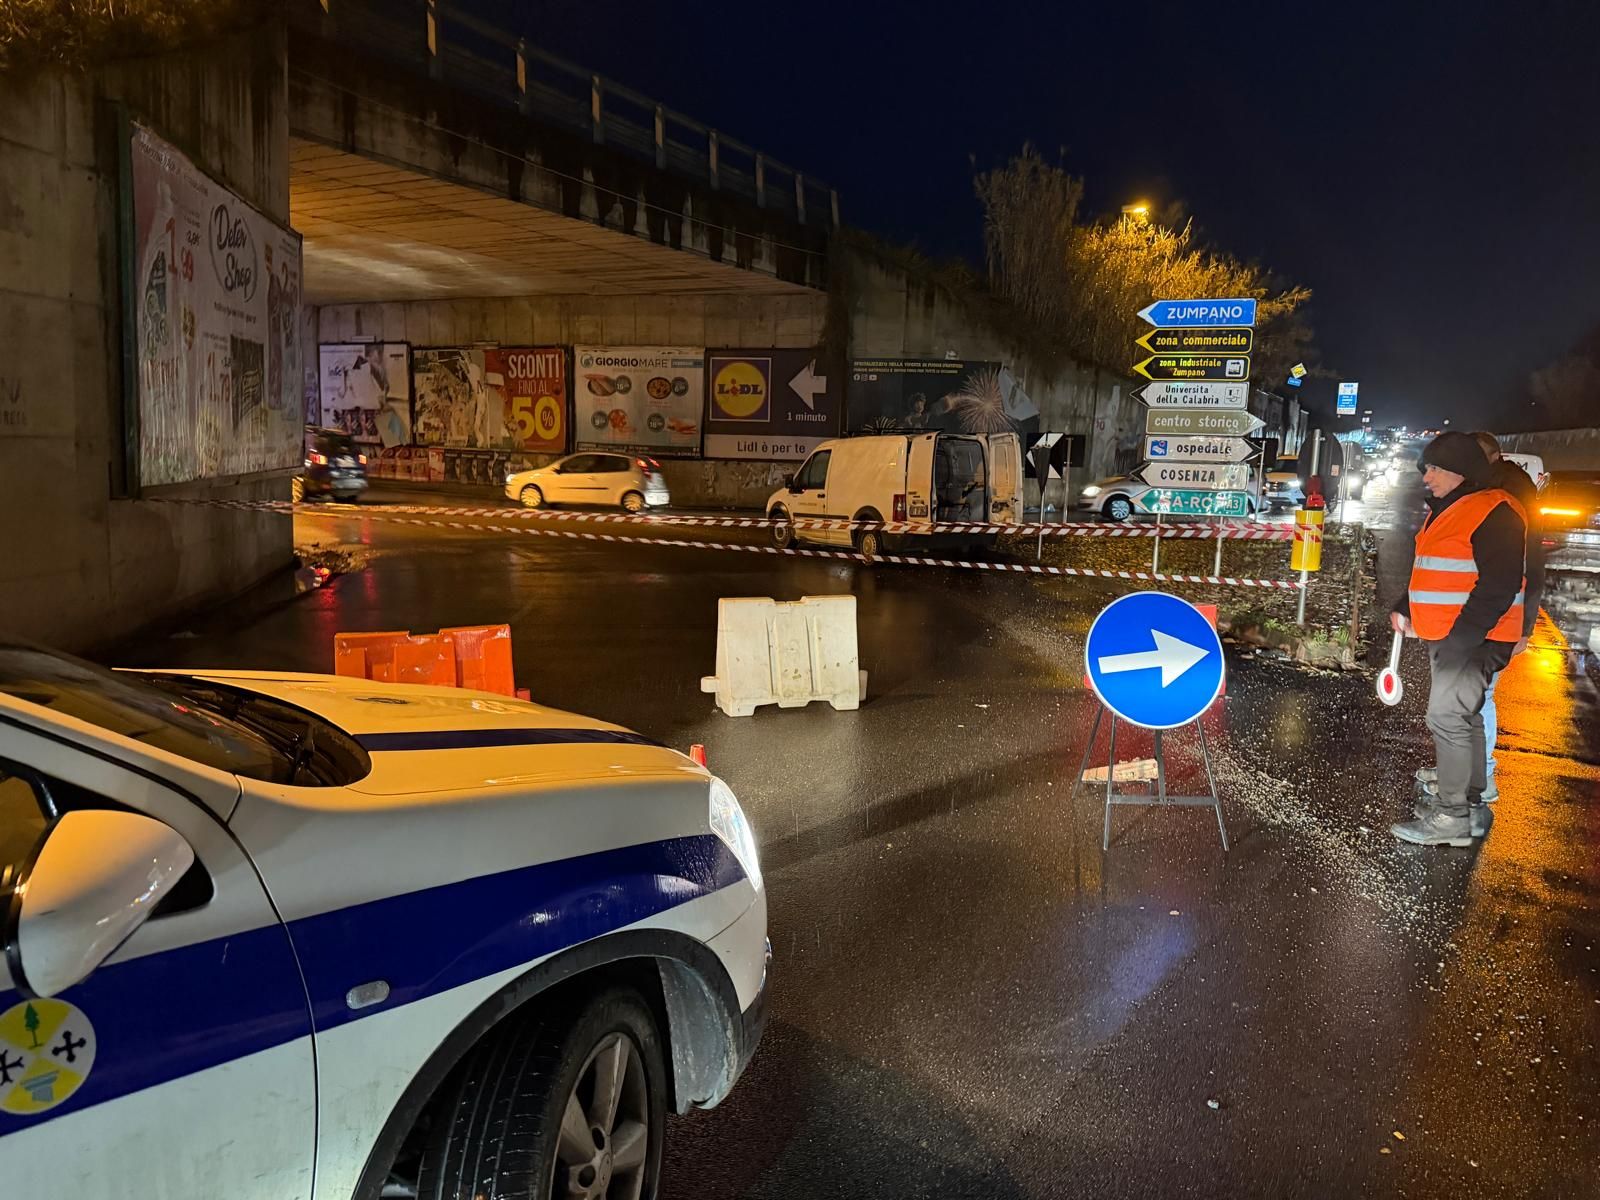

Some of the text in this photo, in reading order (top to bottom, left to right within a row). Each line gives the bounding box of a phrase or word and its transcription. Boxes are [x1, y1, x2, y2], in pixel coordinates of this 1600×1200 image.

[224, 253, 251, 299] Shop
[1167, 305, 1243, 320] ZUMPANO
[1156, 334, 1247, 346] zona commerciale
[1159, 358, 1222, 367] zona industriale
[1172, 368, 1206, 377] Zumpano
[518, 380, 550, 395] FINO AL
[1156, 395, 1219, 405] della Calabria
[795, 412, 827, 422] minuto
[1154, 415, 1239, 429] centro storico
[737, 440, 806, 455] Lidl è per te
[1176, 442, 1232, 456] ospedale
[1160, 469, 1216, 482] COSENZA
